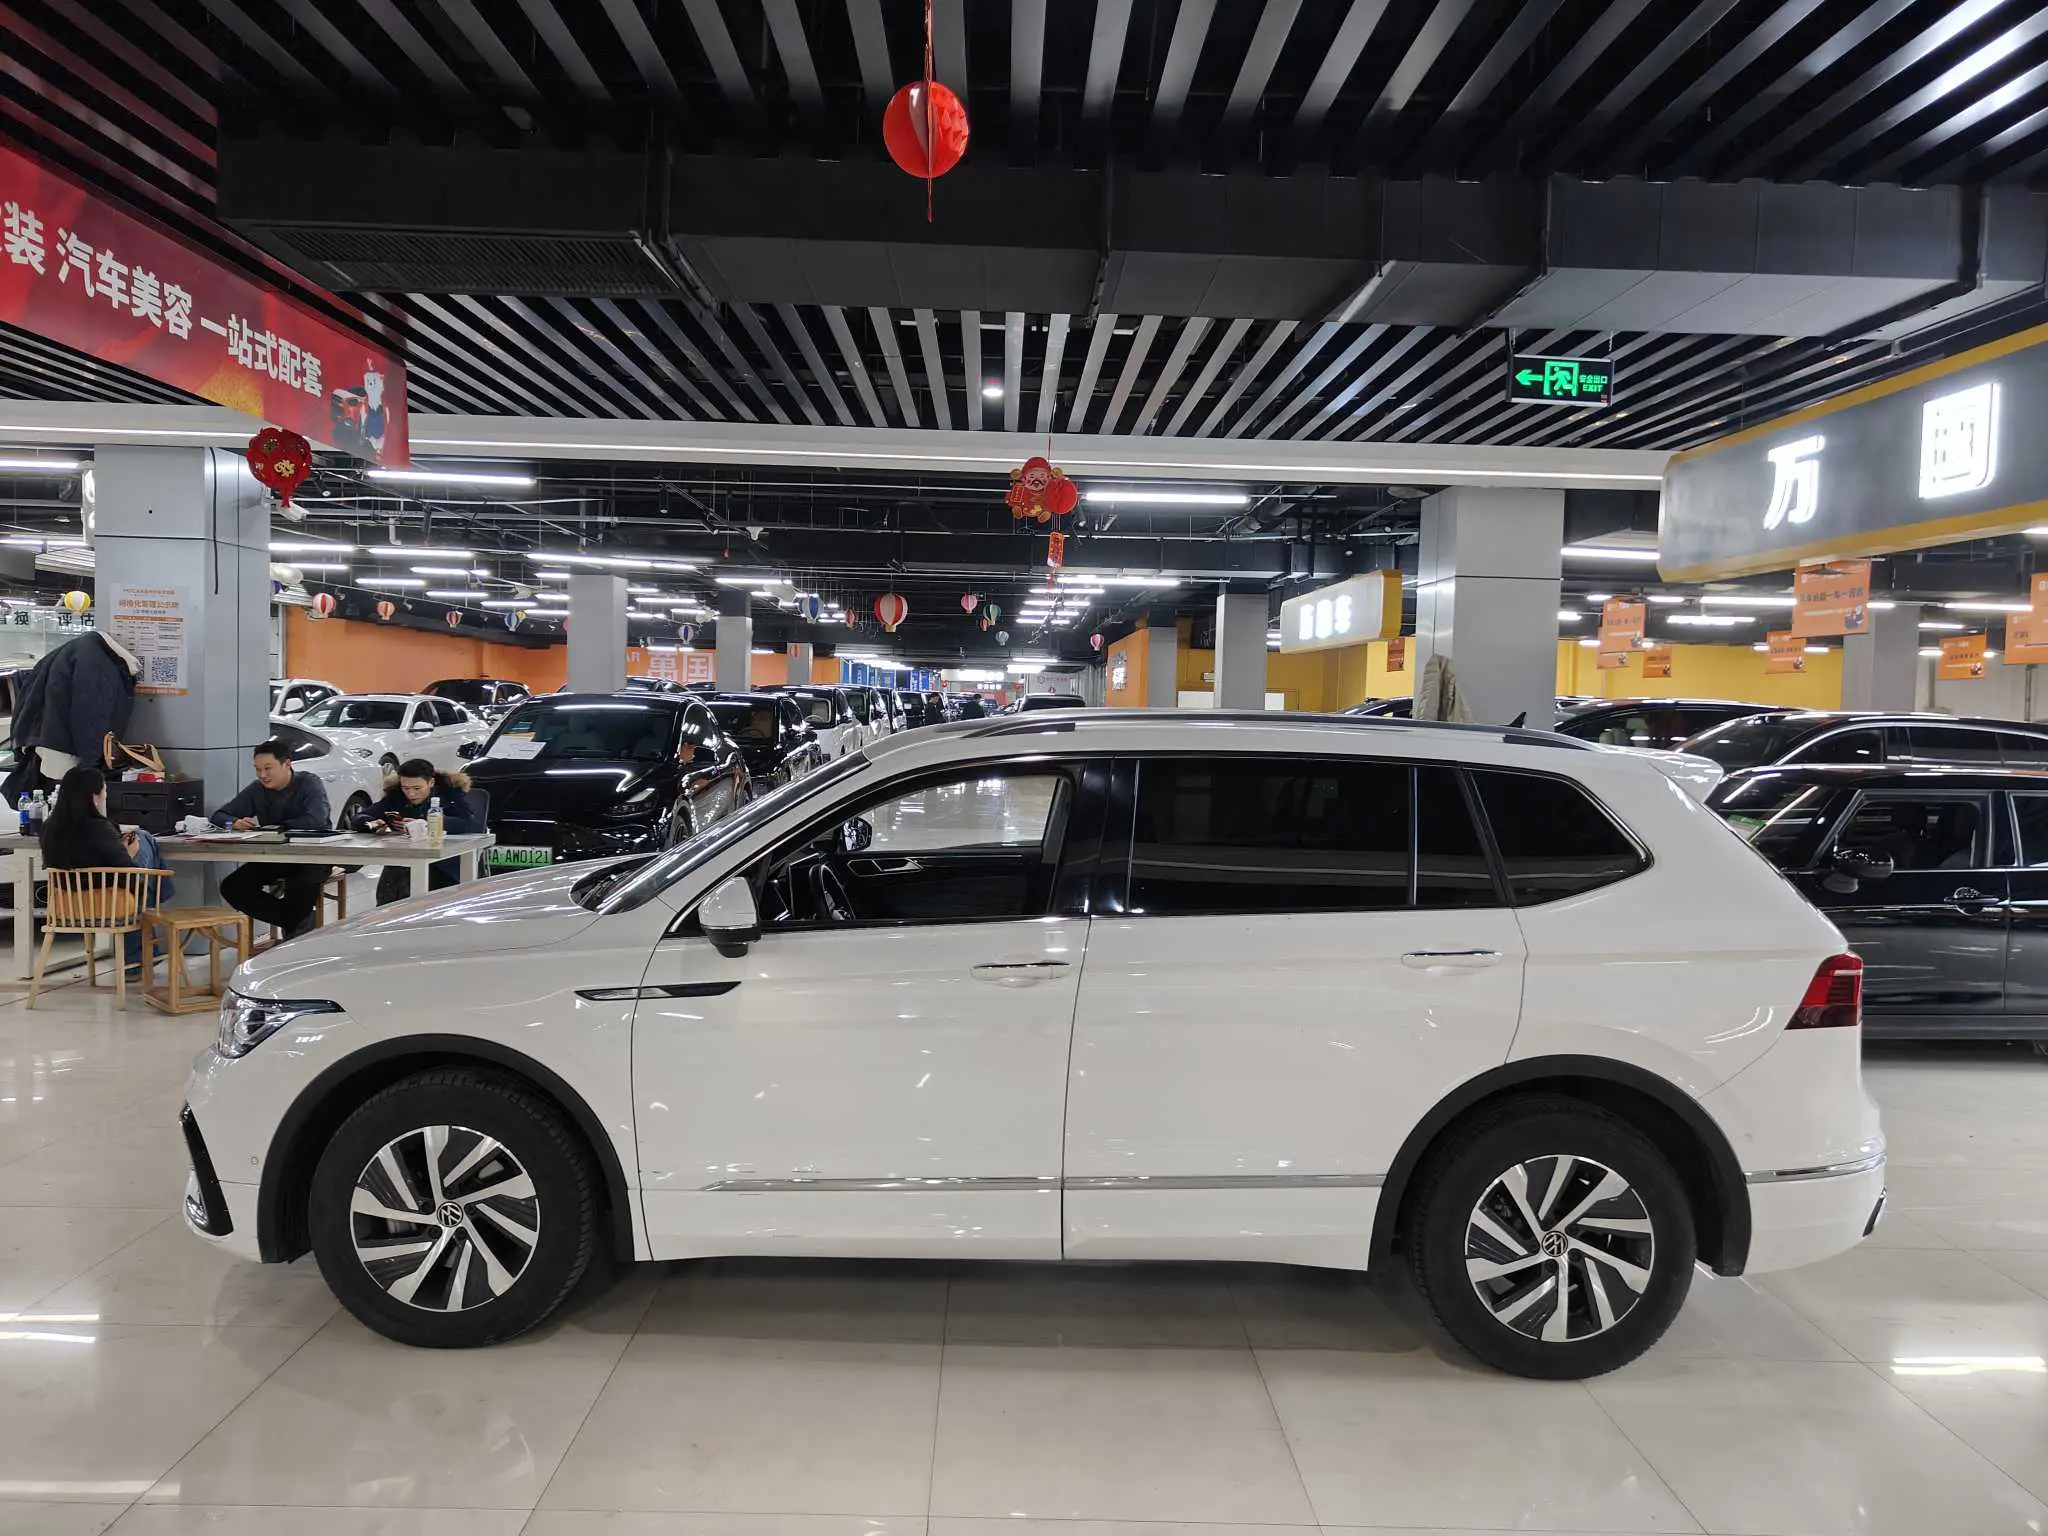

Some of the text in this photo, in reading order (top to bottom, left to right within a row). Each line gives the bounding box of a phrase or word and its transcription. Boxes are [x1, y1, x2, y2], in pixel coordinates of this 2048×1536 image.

[0, 200, 323, 399] 装 汽车美容 一站式配套
[1579, 374, 1608, 385] 安全出口
[1582, 384, 1604, 393] EXIT
[505, 849, 549, 864] AW0121
